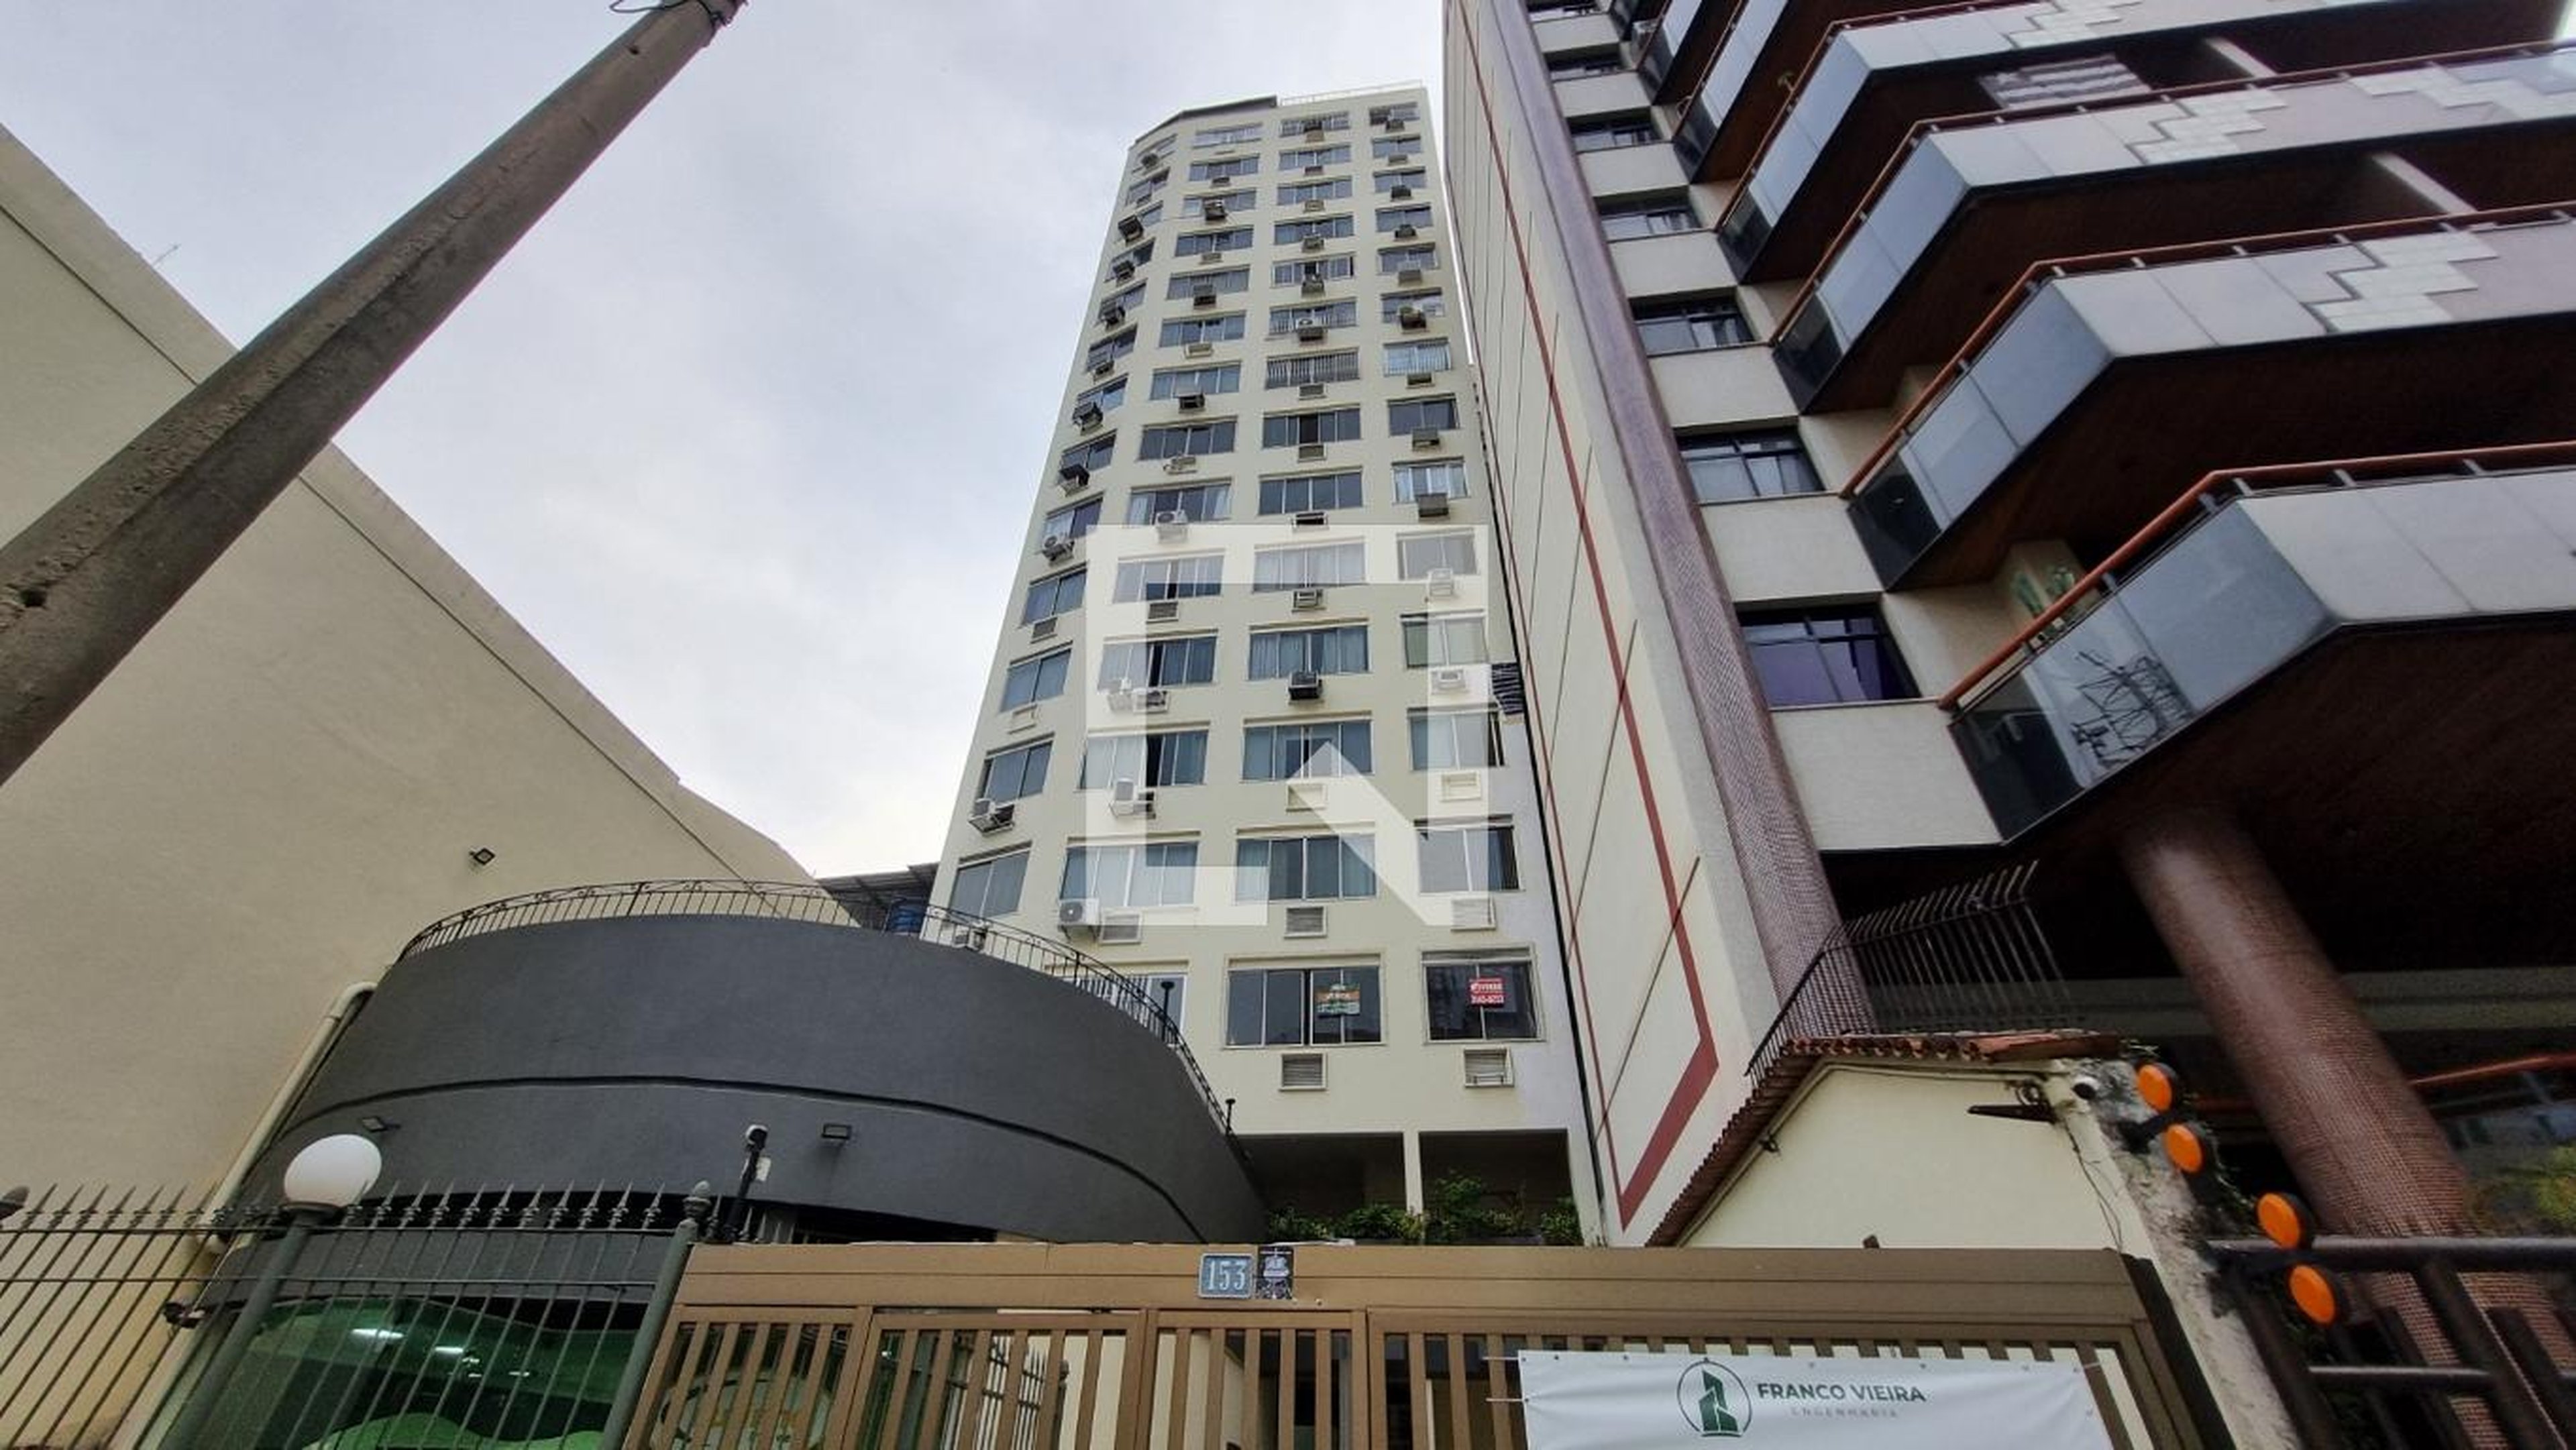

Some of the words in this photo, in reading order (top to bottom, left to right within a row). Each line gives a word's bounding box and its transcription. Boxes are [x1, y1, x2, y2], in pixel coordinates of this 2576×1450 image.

[1208, 1260, 1246, 1291] 153
[1757, 1383, 1845, 1400] FRANCO
[1849, 1384, 1927, 1402] VIEIRA
[1790, 1407, 1898, 1418] ENGENHARIA
